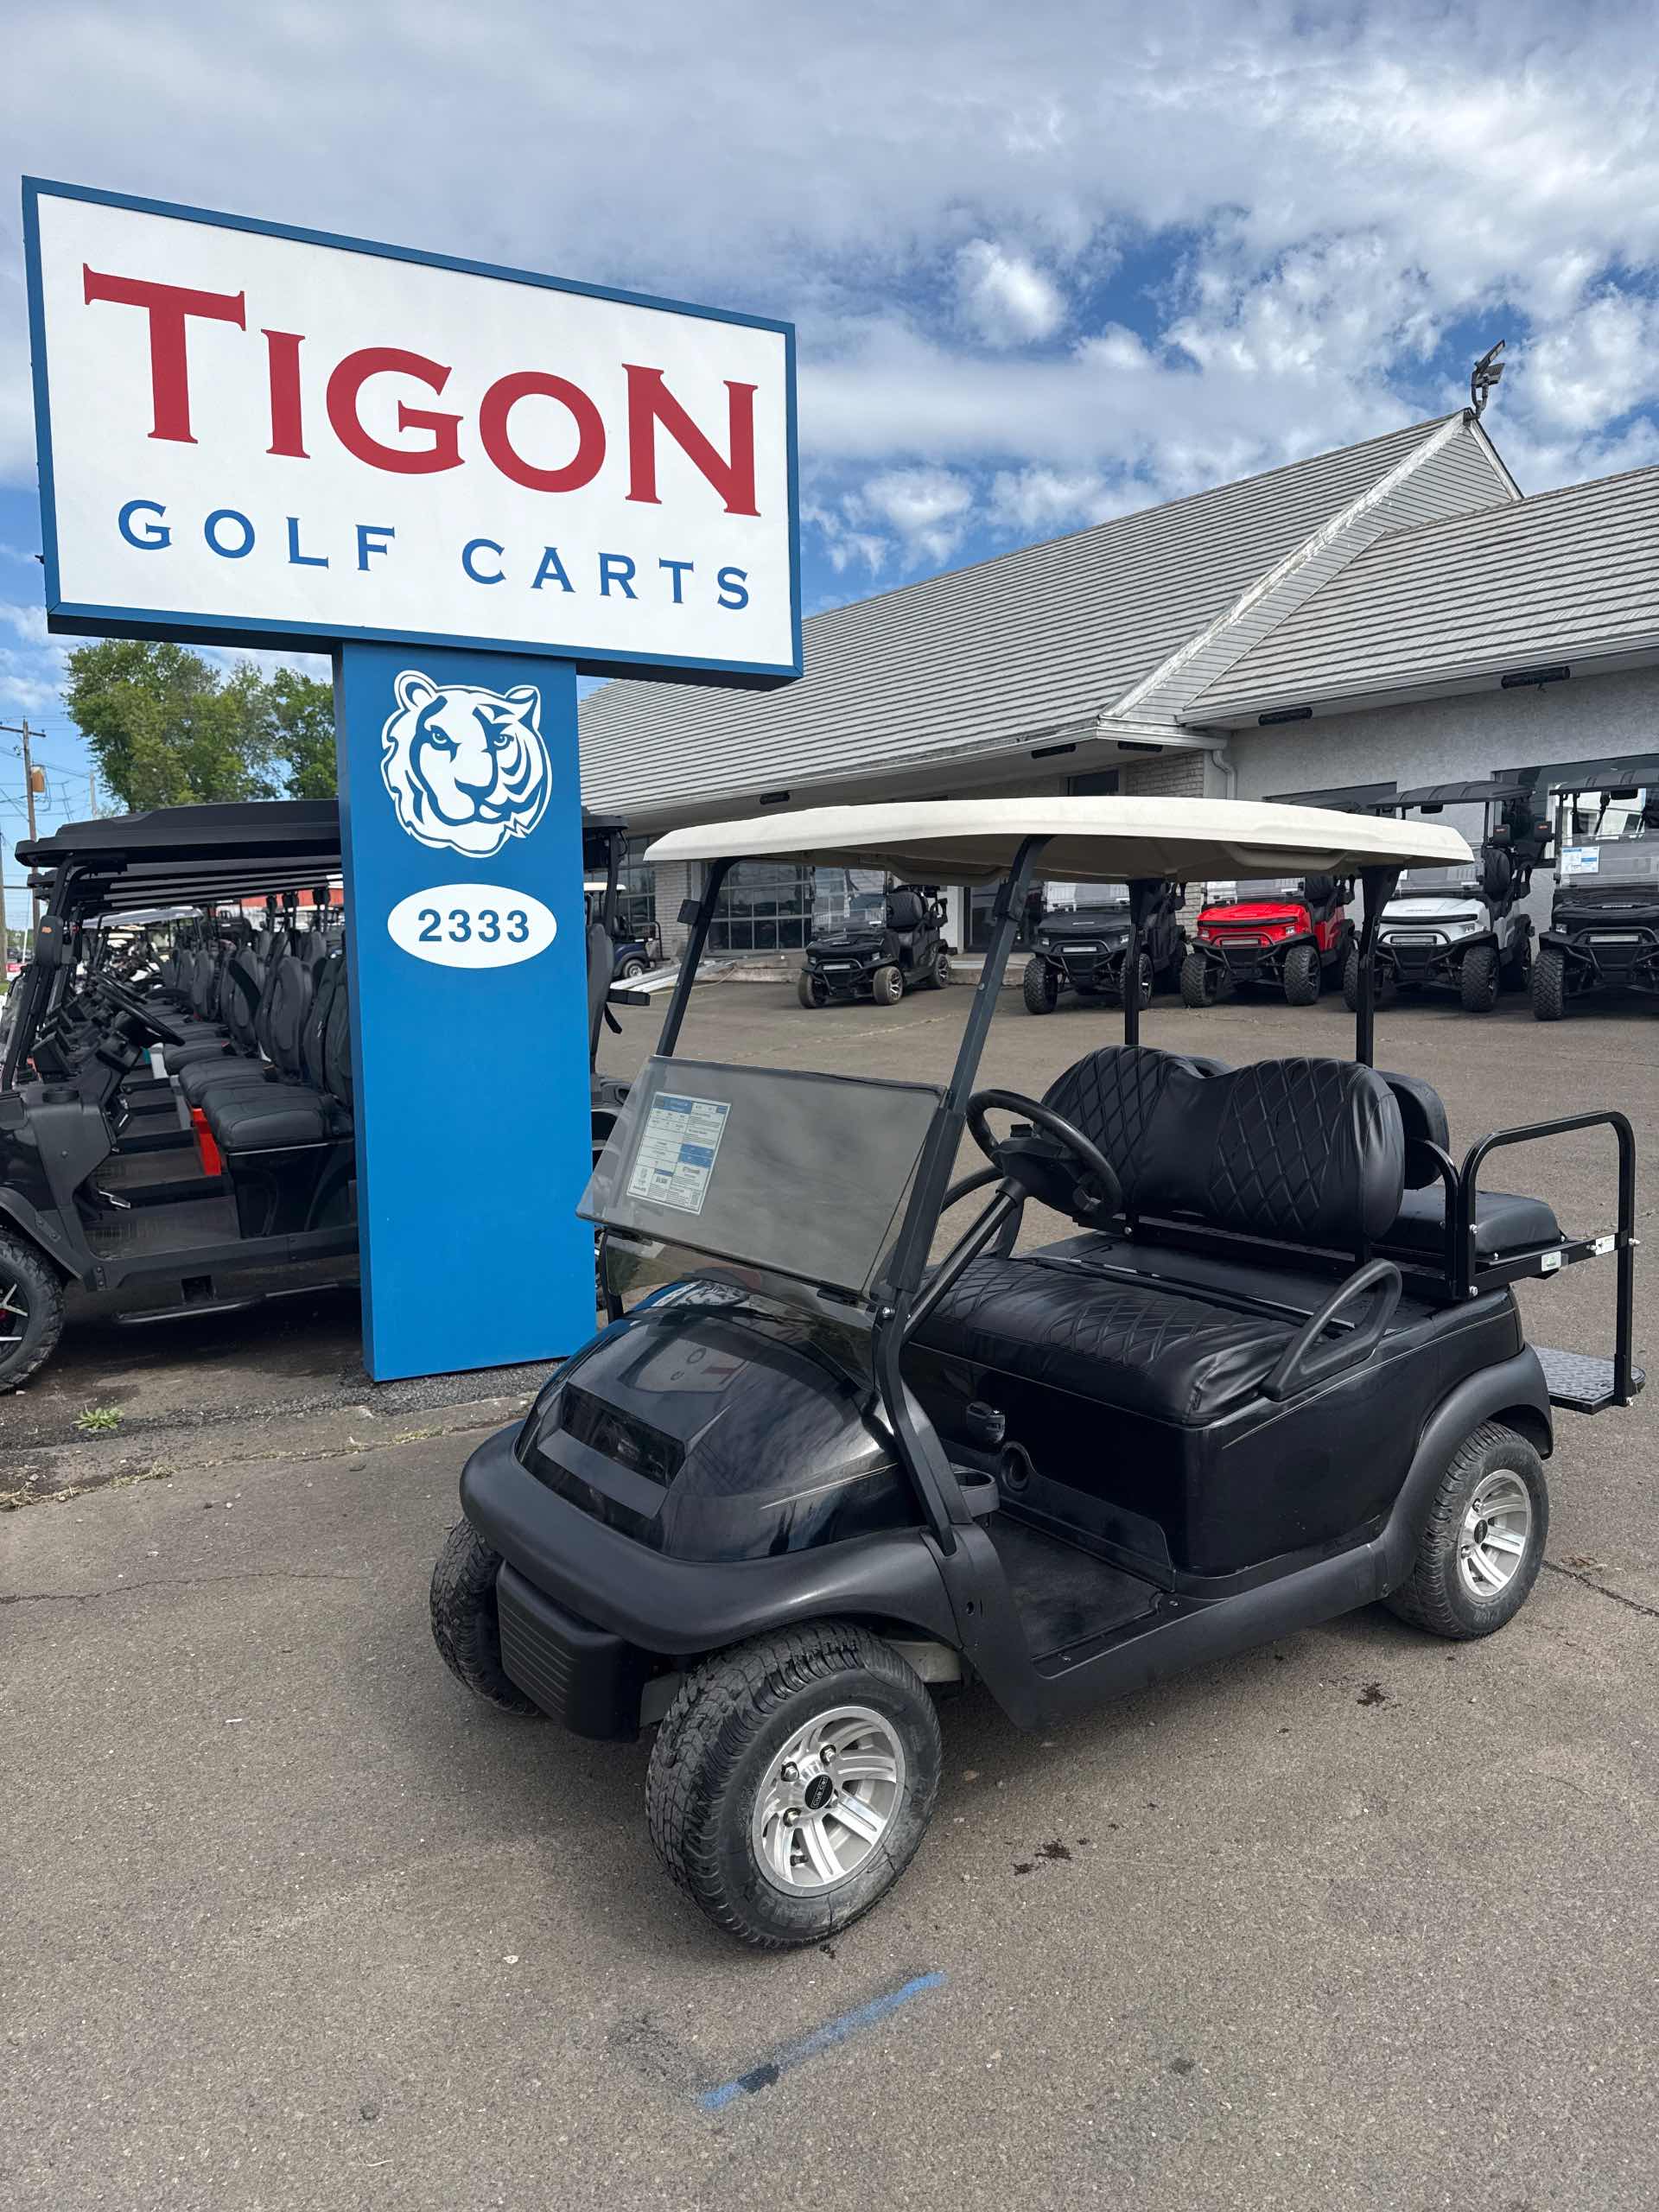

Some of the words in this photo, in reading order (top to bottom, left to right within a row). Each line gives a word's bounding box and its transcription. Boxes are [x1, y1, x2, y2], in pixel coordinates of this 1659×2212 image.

[83, 263, 761, 517] TIGON
[118, 499, 396, 572] GOLF
[461, 537, 751, 610] CARTS
[417, 908, 530, 944] 2333
